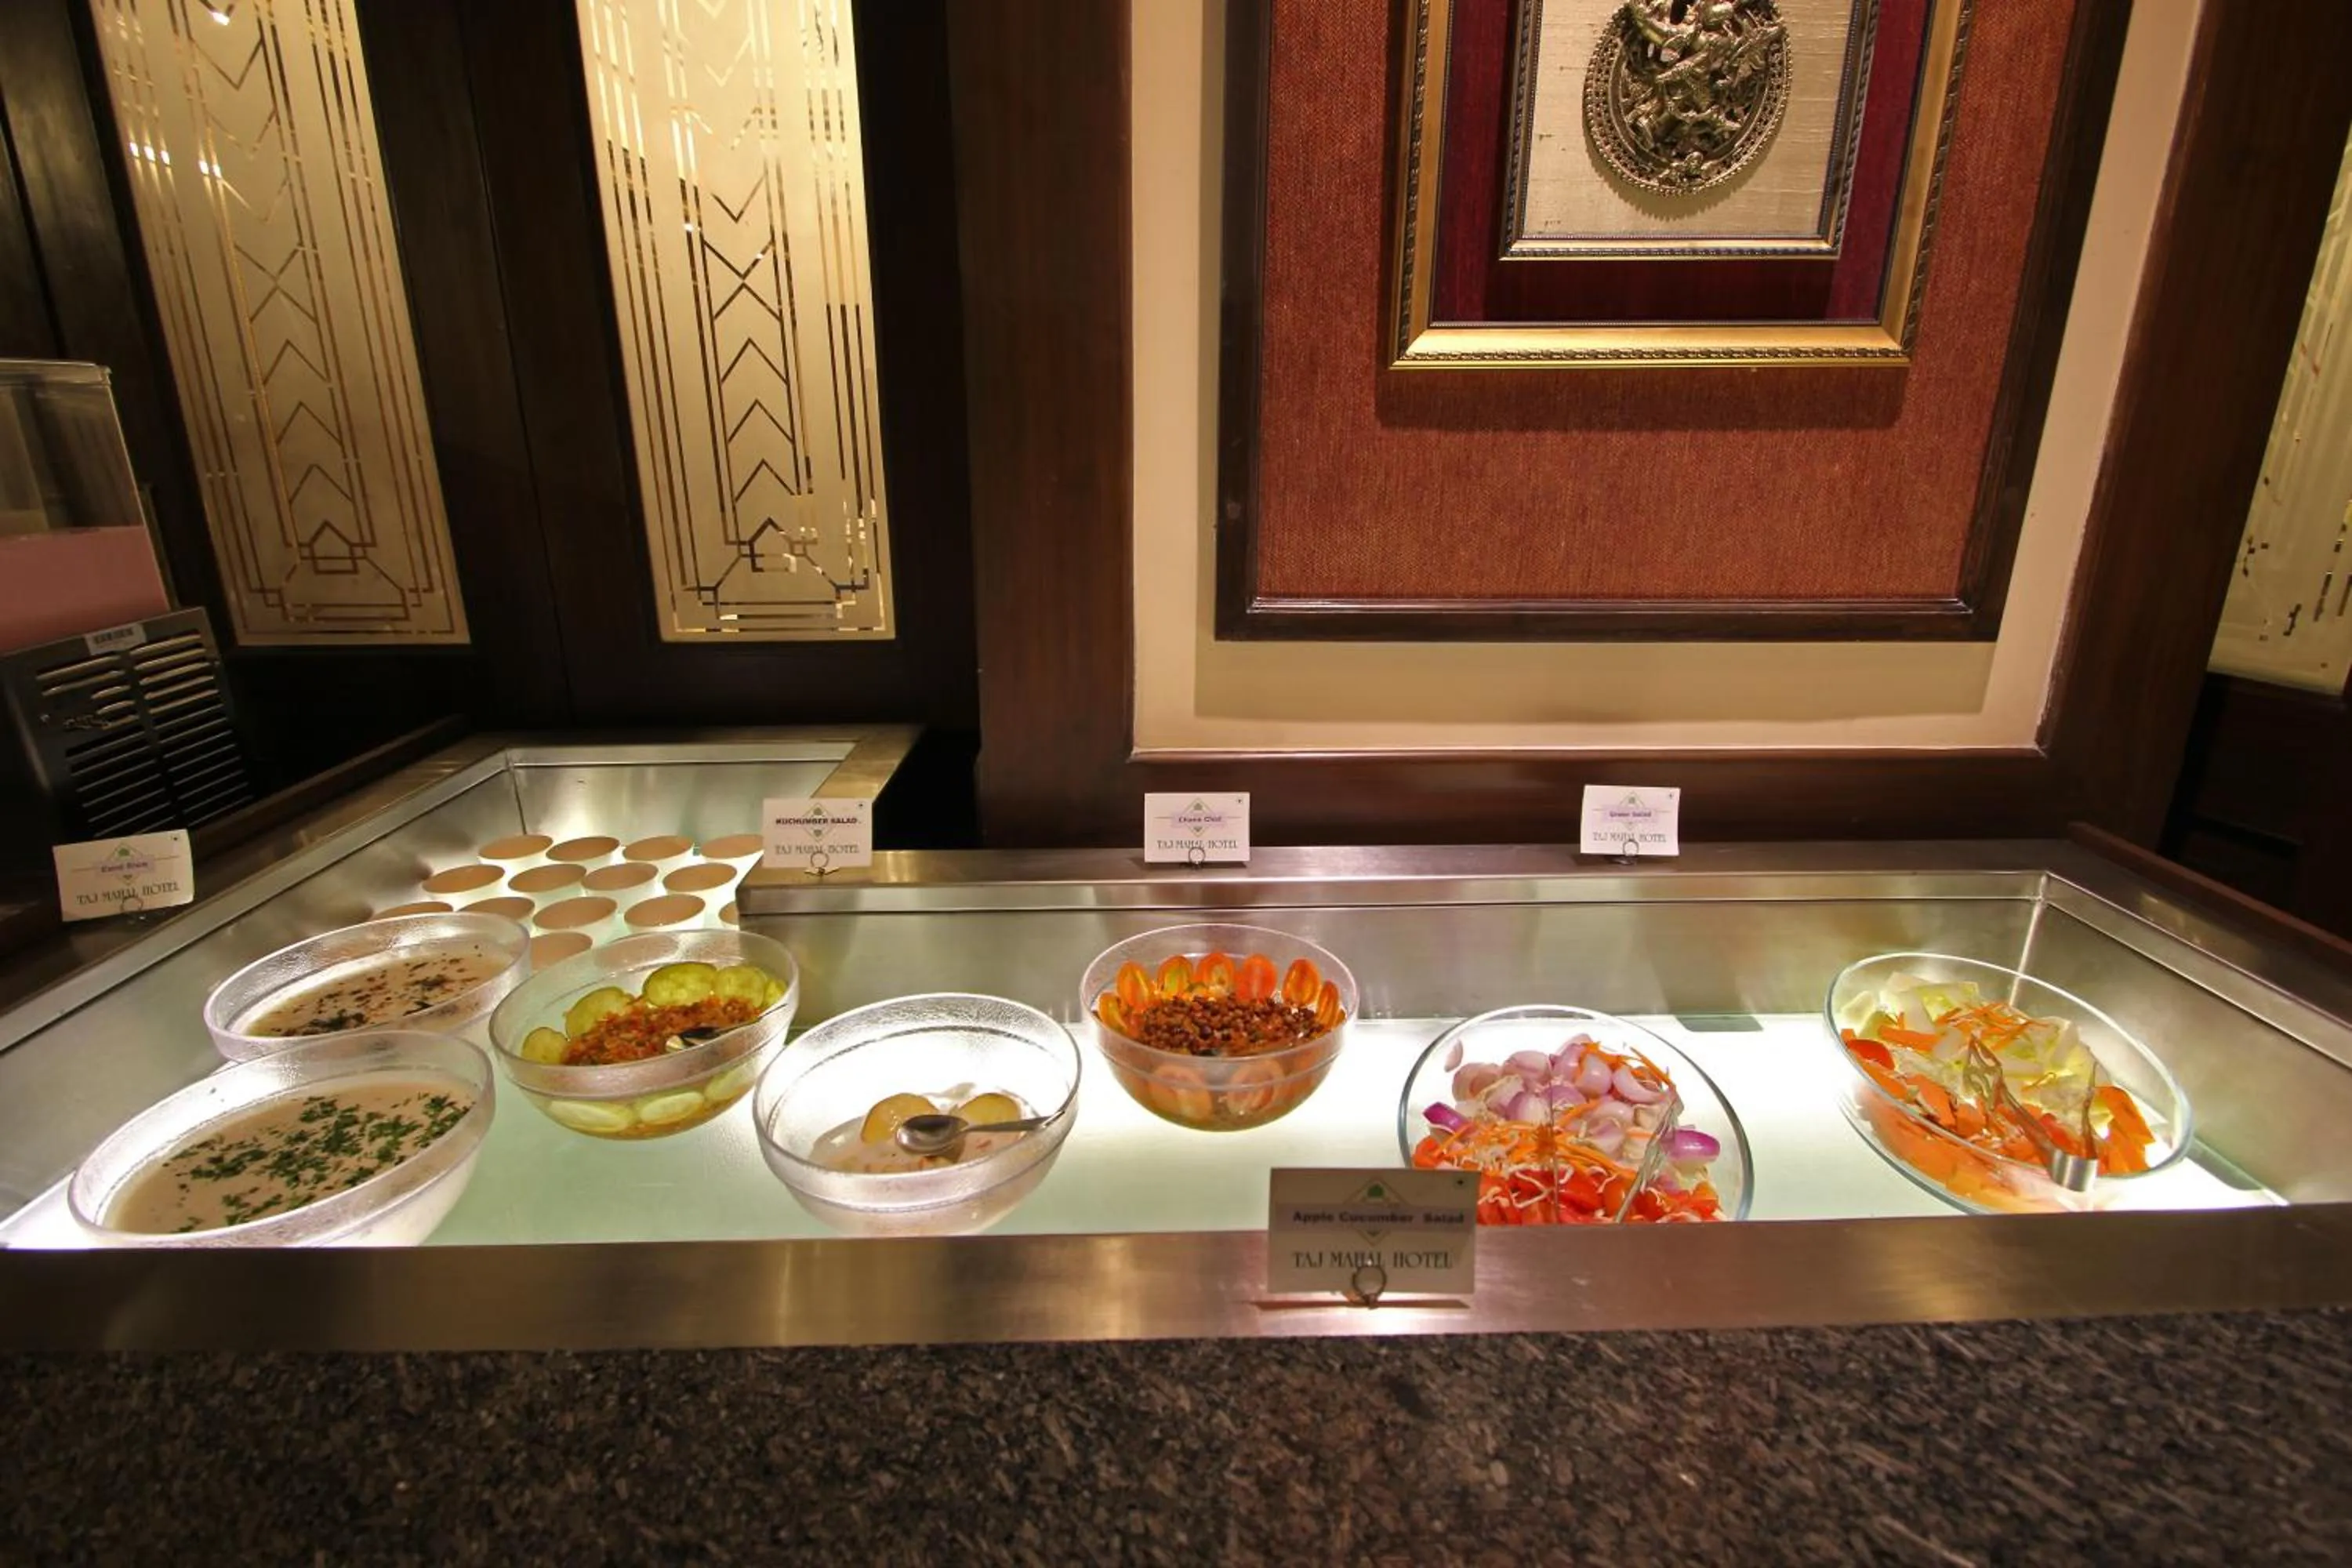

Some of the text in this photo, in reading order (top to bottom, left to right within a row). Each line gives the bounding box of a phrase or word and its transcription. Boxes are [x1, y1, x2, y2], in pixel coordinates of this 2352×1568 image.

[141, 881, 180, 896] HOTEL
[1293, 1210, 1465, 1225] Apple Cucumber Salad
[1291, 1250, 1454, 1269] TAJ MAHAL HOTEL
